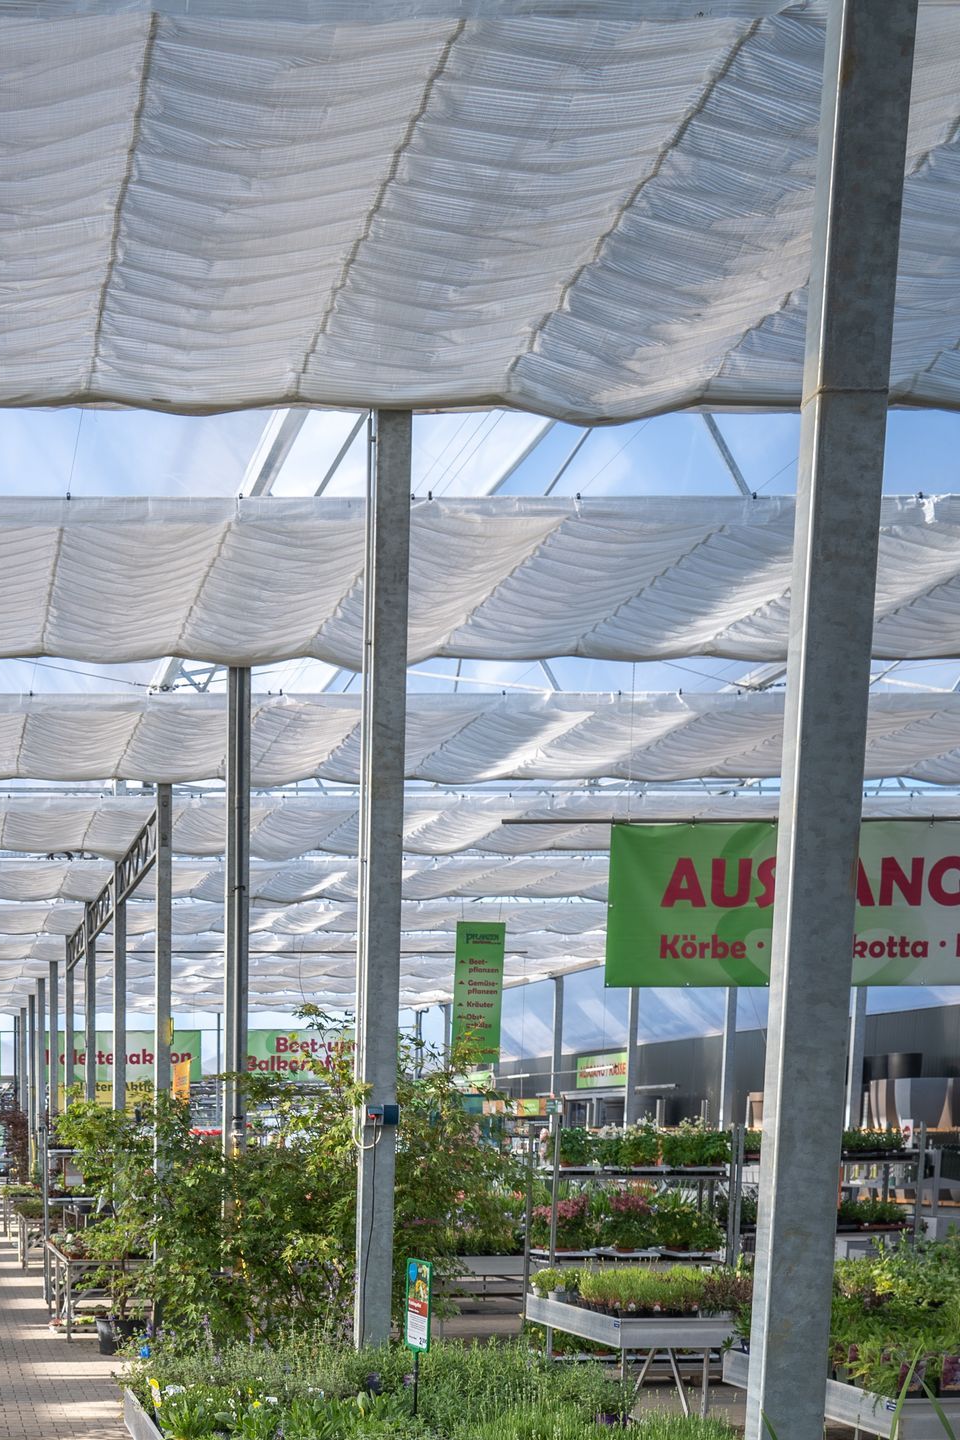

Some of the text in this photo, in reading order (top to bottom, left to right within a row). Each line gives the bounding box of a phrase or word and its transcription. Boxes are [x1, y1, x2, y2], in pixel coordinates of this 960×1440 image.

[660, 934, 747, 959] Körbe
[468, 979, 498, 987] Gemüse-
[467, 1000, 494, 1008] Kräuter
